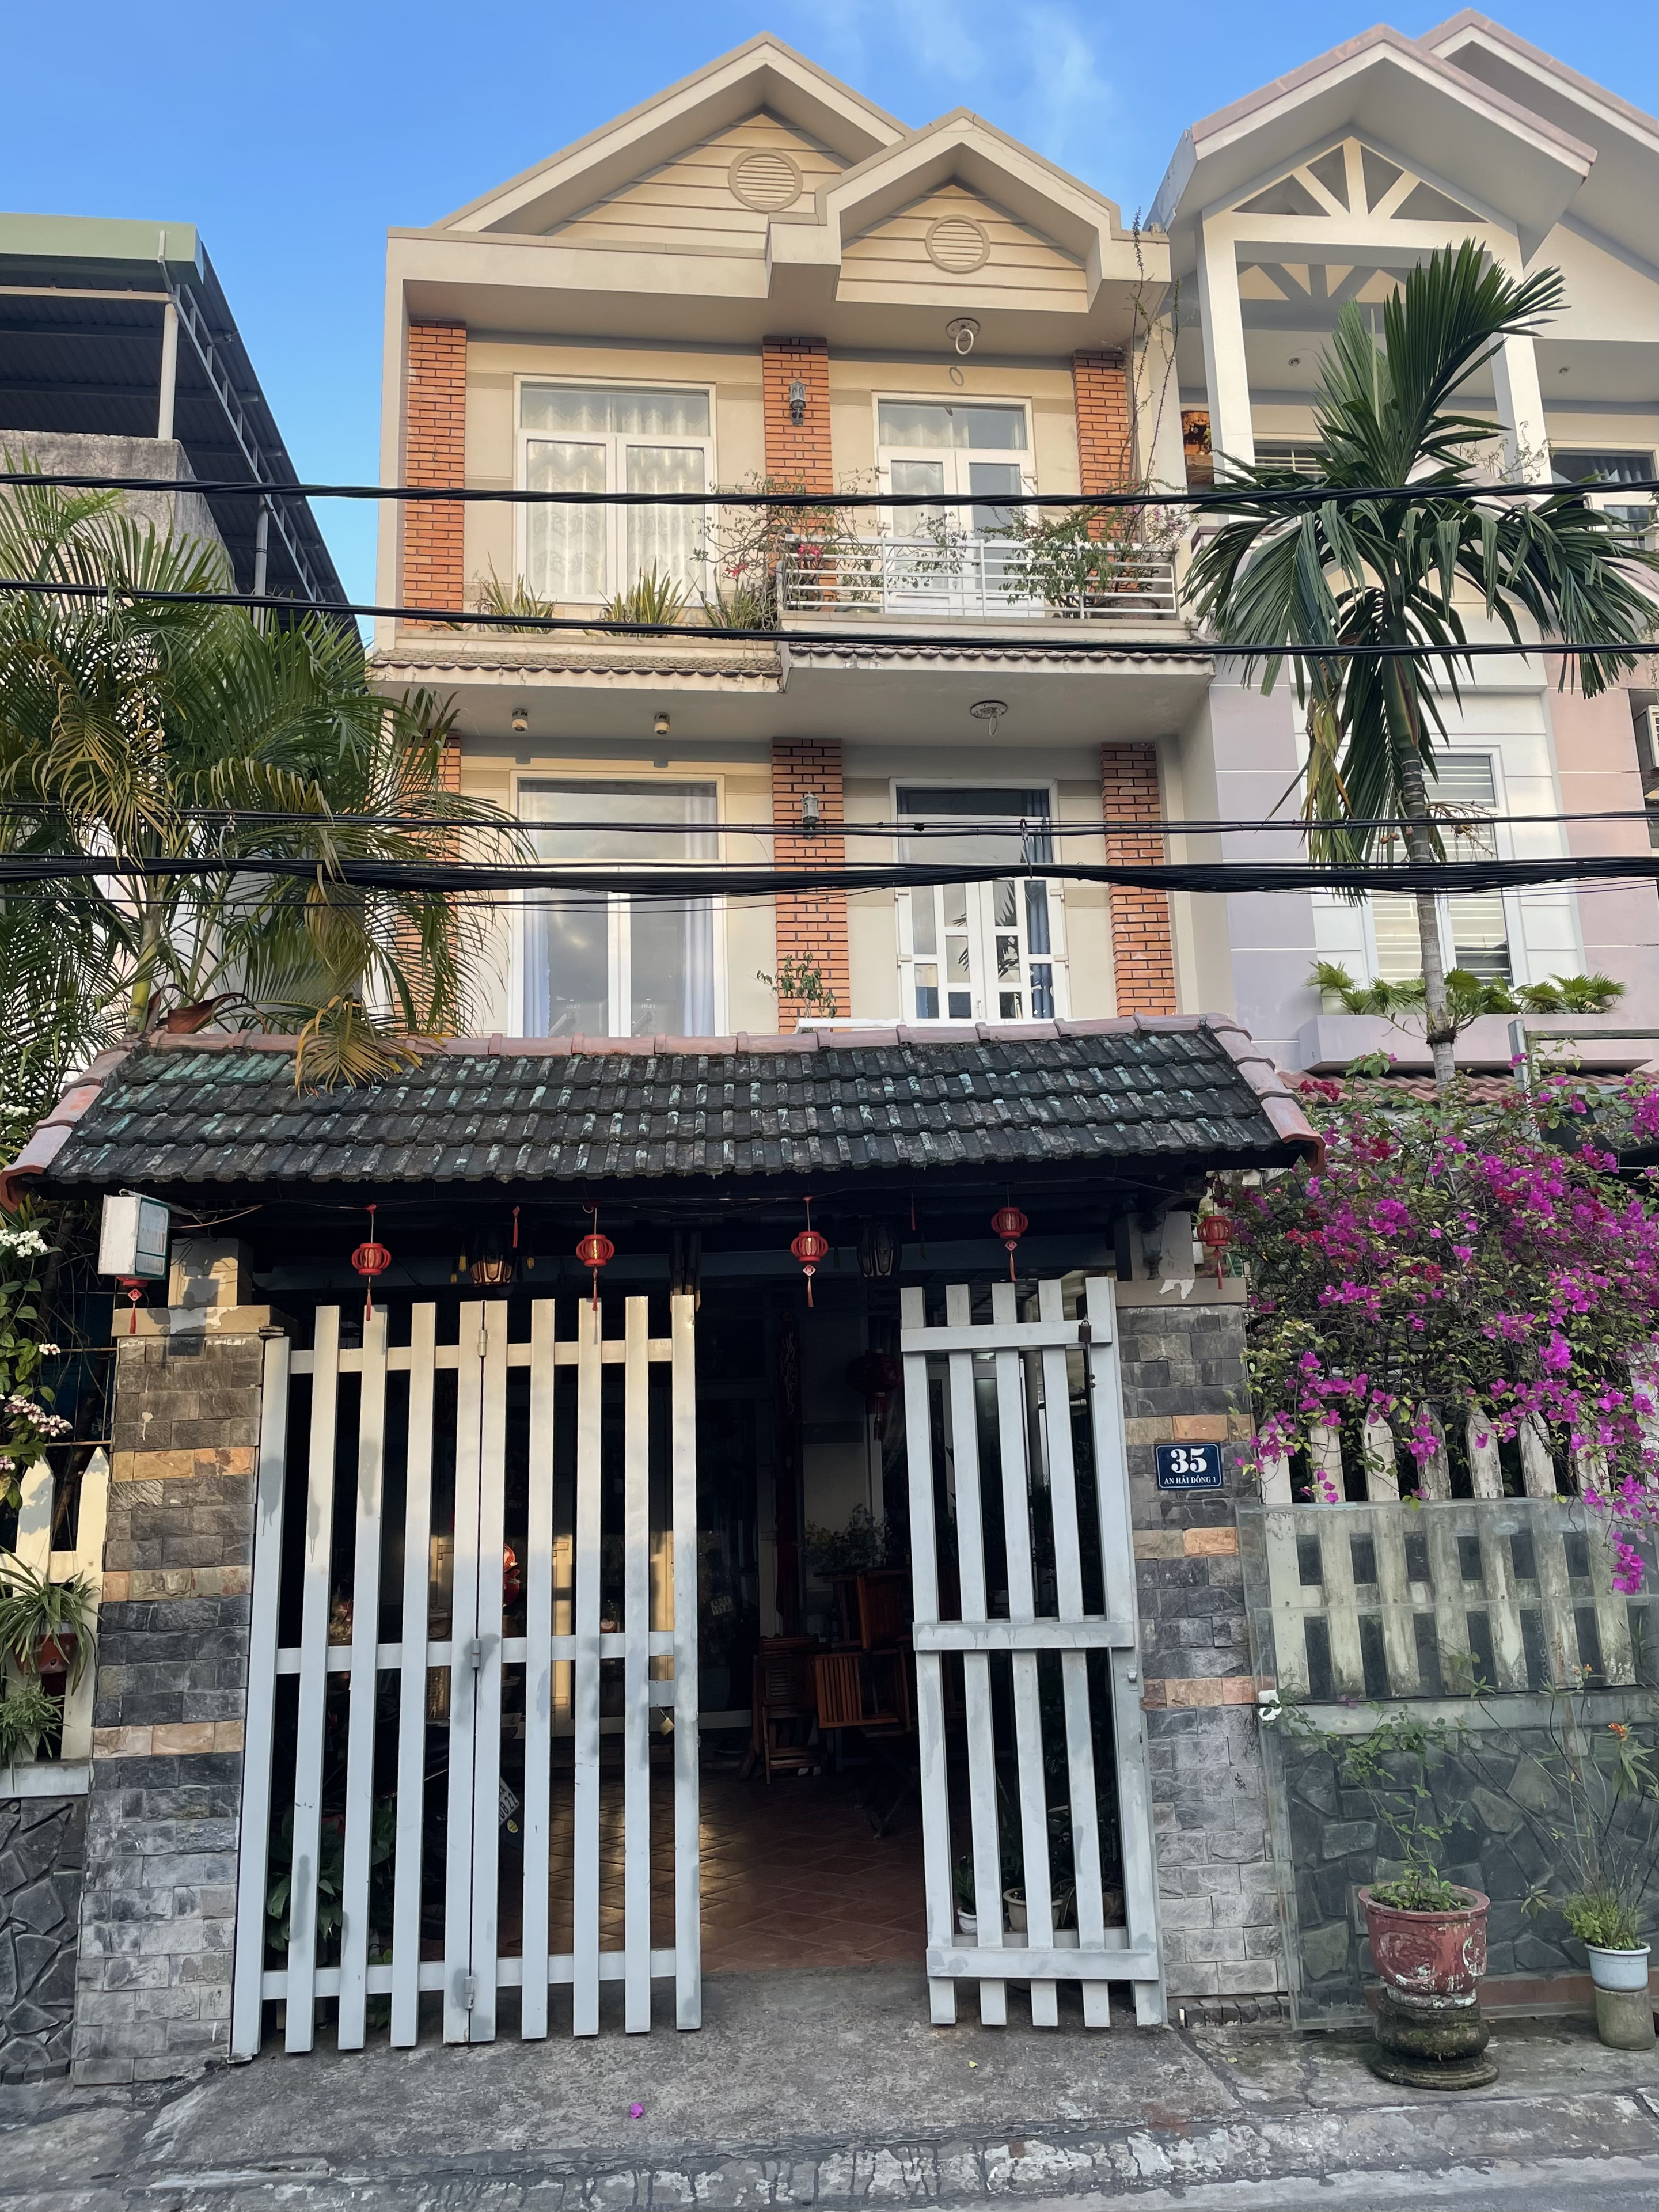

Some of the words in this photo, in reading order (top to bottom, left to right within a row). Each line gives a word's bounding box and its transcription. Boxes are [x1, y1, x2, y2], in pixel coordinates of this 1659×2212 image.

[1171, 1448, 1207, 1473] 35
[1176, 1475, 1189, 1484] HẢI
[1191, 1475, 1211, 1484] ĐÔNG
